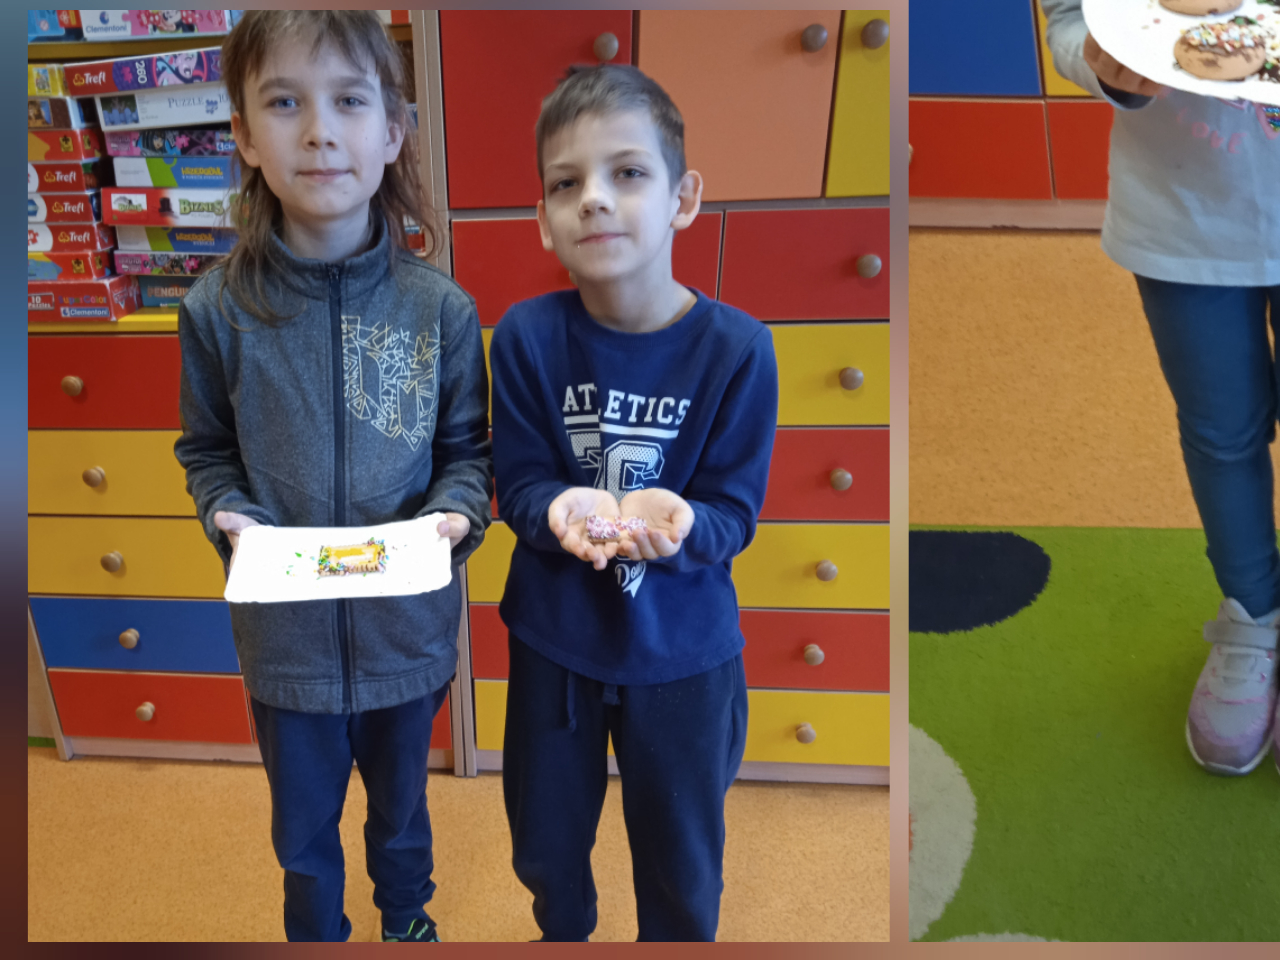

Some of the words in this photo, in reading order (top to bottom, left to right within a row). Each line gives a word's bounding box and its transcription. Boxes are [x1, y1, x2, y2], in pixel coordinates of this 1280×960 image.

[86, 24, 127, 34] Clementoni
[135, 60, 148, 84] 260
[84, 71, 106, 85] Trefl
[168, 96, 204, 109] PUZZLE
[55, 171, 77, 182] Trefl
[63, 202, 85, 213] Trefl
[179, 198, 224, 216] BIZNES
[69, 231, 91, 243] Trefl
[30, 296, 41, 304] 10
[70, 308, 109, 317] Clementoni
